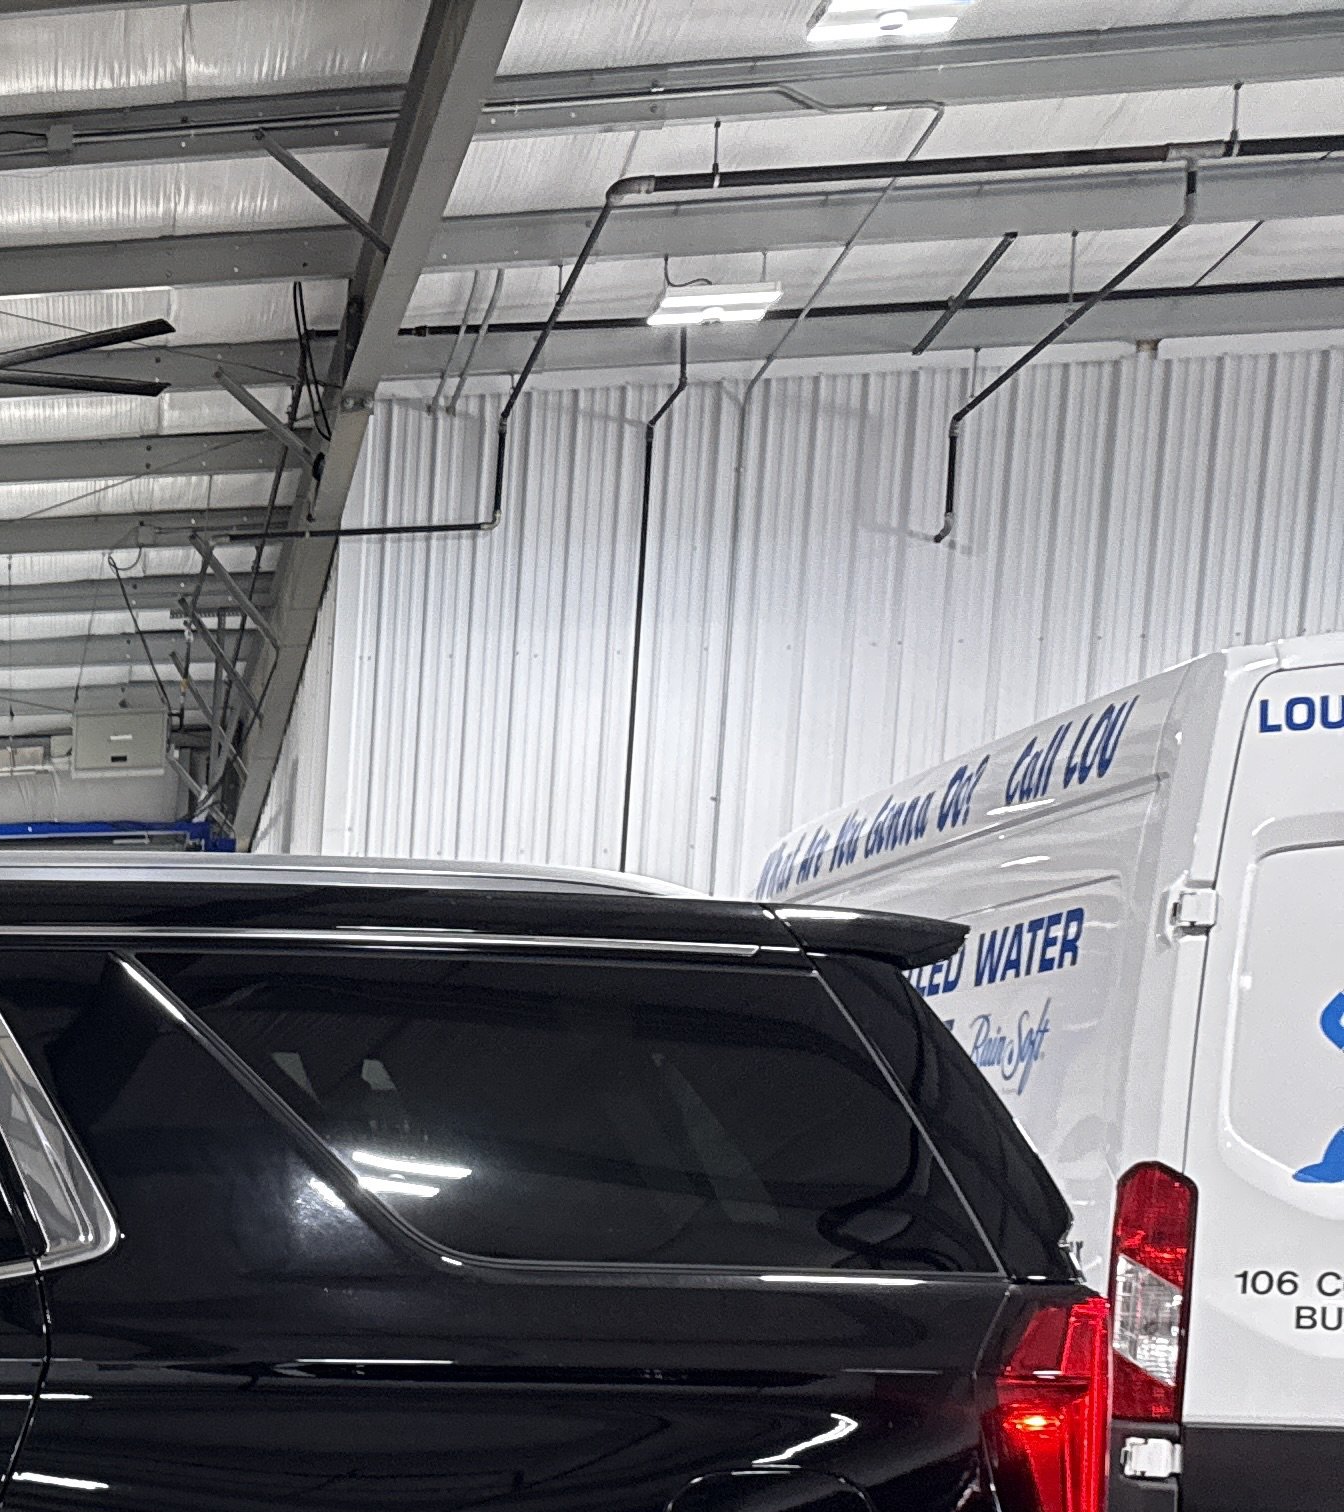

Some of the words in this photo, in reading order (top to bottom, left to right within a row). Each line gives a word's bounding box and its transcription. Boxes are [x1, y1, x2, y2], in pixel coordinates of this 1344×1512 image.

[1005, 736, 1073, 806] Call
[1064, 694, 1140, 789] LOU
[974, 907, 1085, 987] WATER
[1234, 1270, 1299, 1296] 106
[1316, 1271, 1344, 1297] C
[1295, 1305, 1343, 1331] BU
